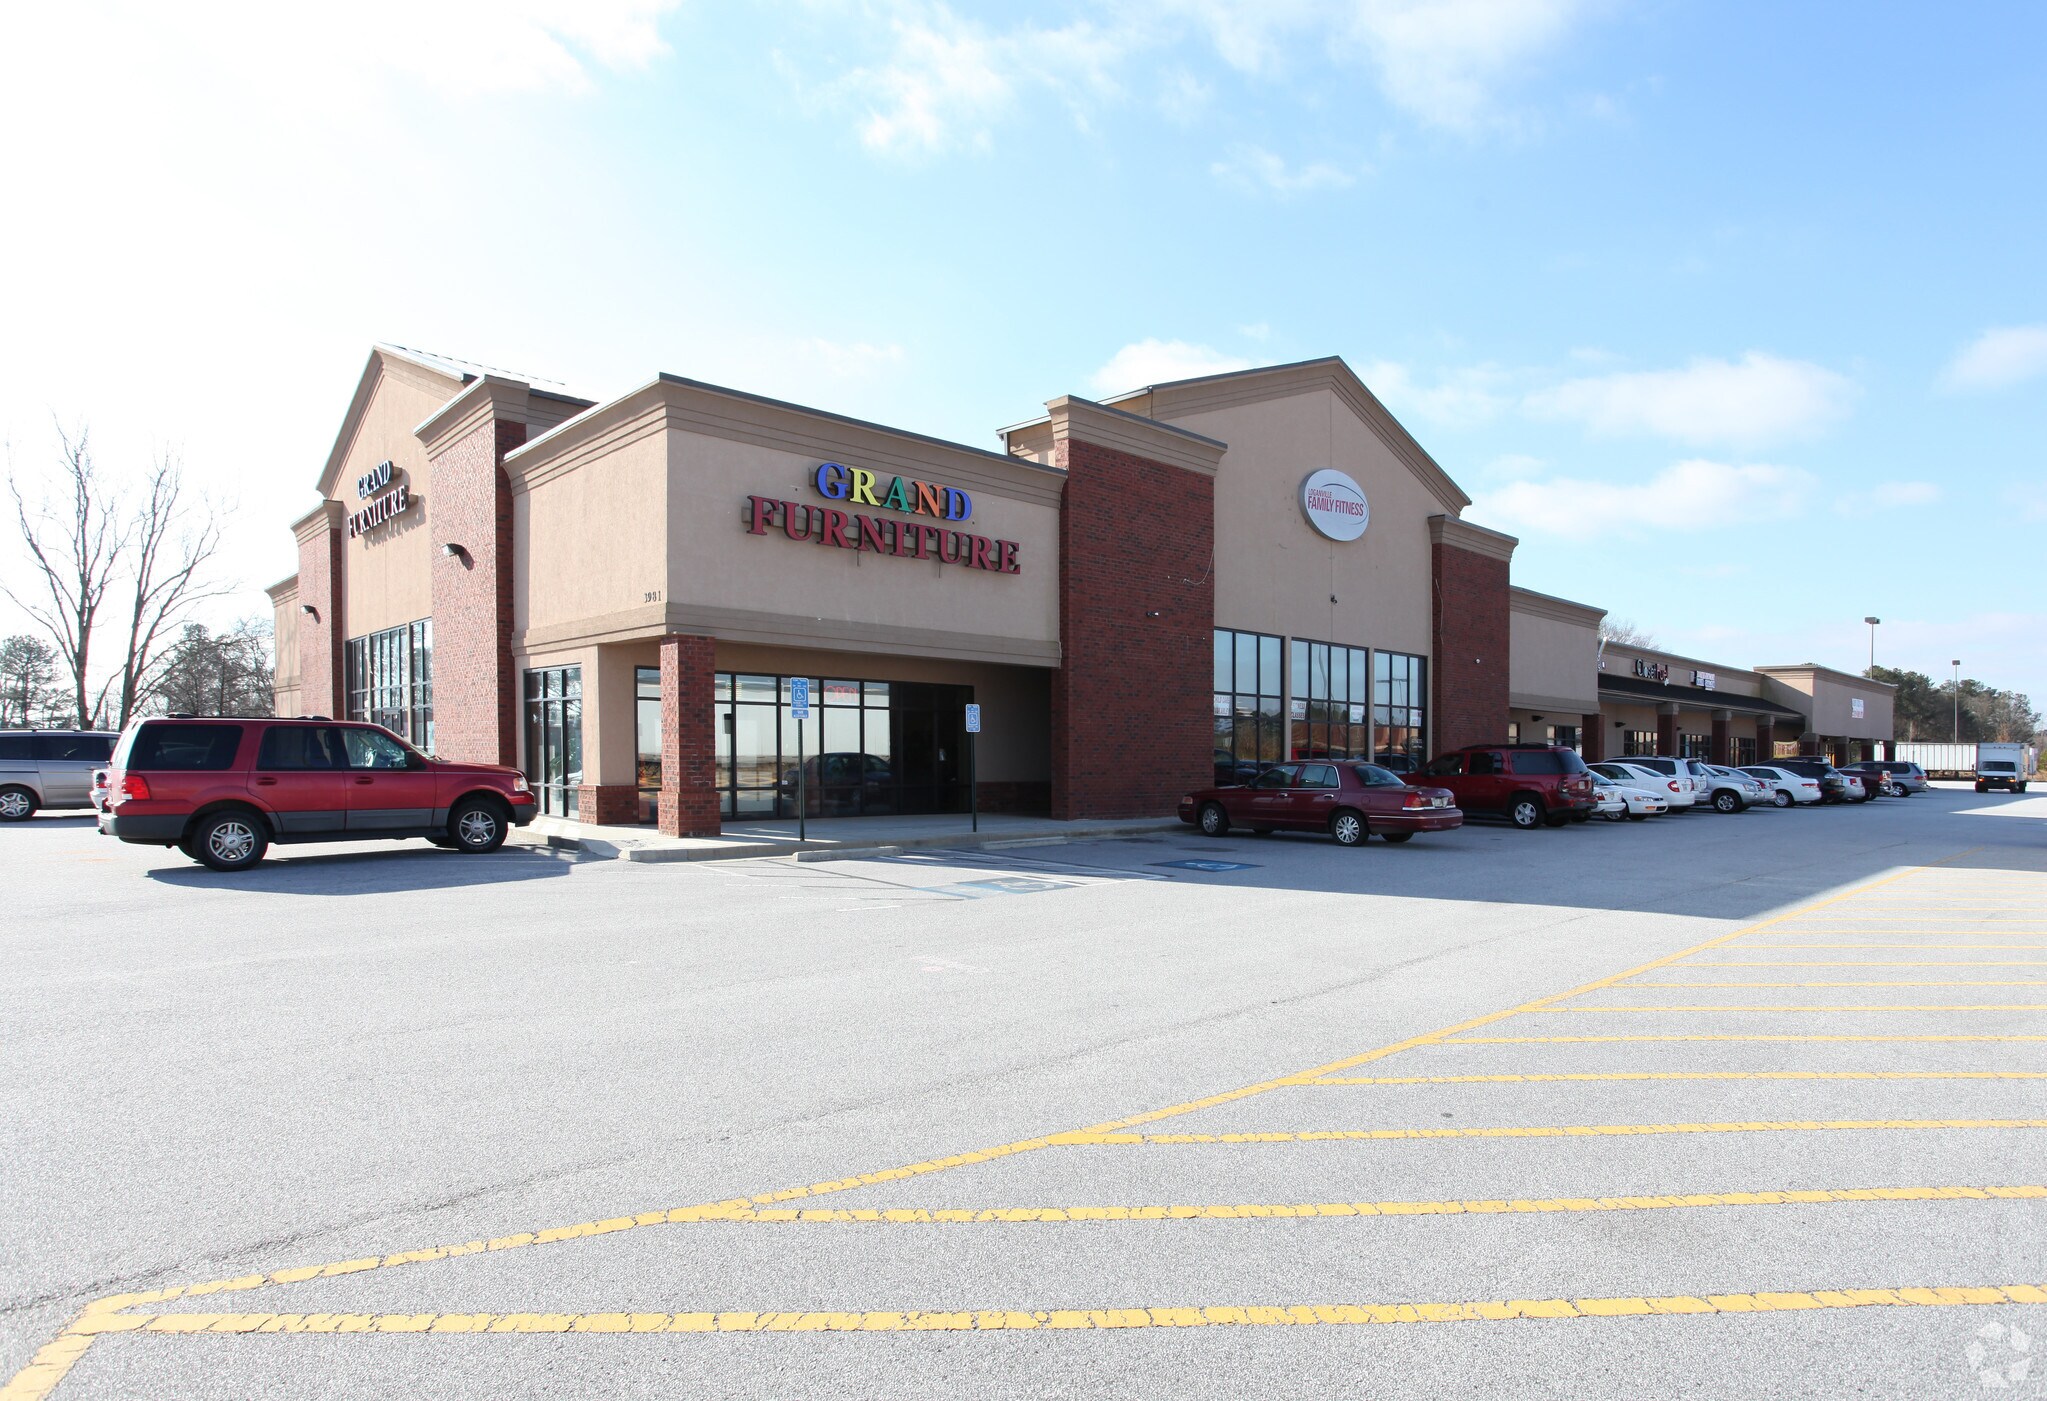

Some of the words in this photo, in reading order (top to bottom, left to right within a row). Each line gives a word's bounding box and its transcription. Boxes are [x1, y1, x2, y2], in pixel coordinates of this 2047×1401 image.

[357, 460, 393, 500] GRAND
[815, 462, 972, 521] GRAND
[1307, 495, 1334, 512] FAMILY
[1335, 500, 1364, 516] FITNESS
[348, 485, 408, 538] FURNITURE
[747, 495, 1021, 575] FURNITURE
